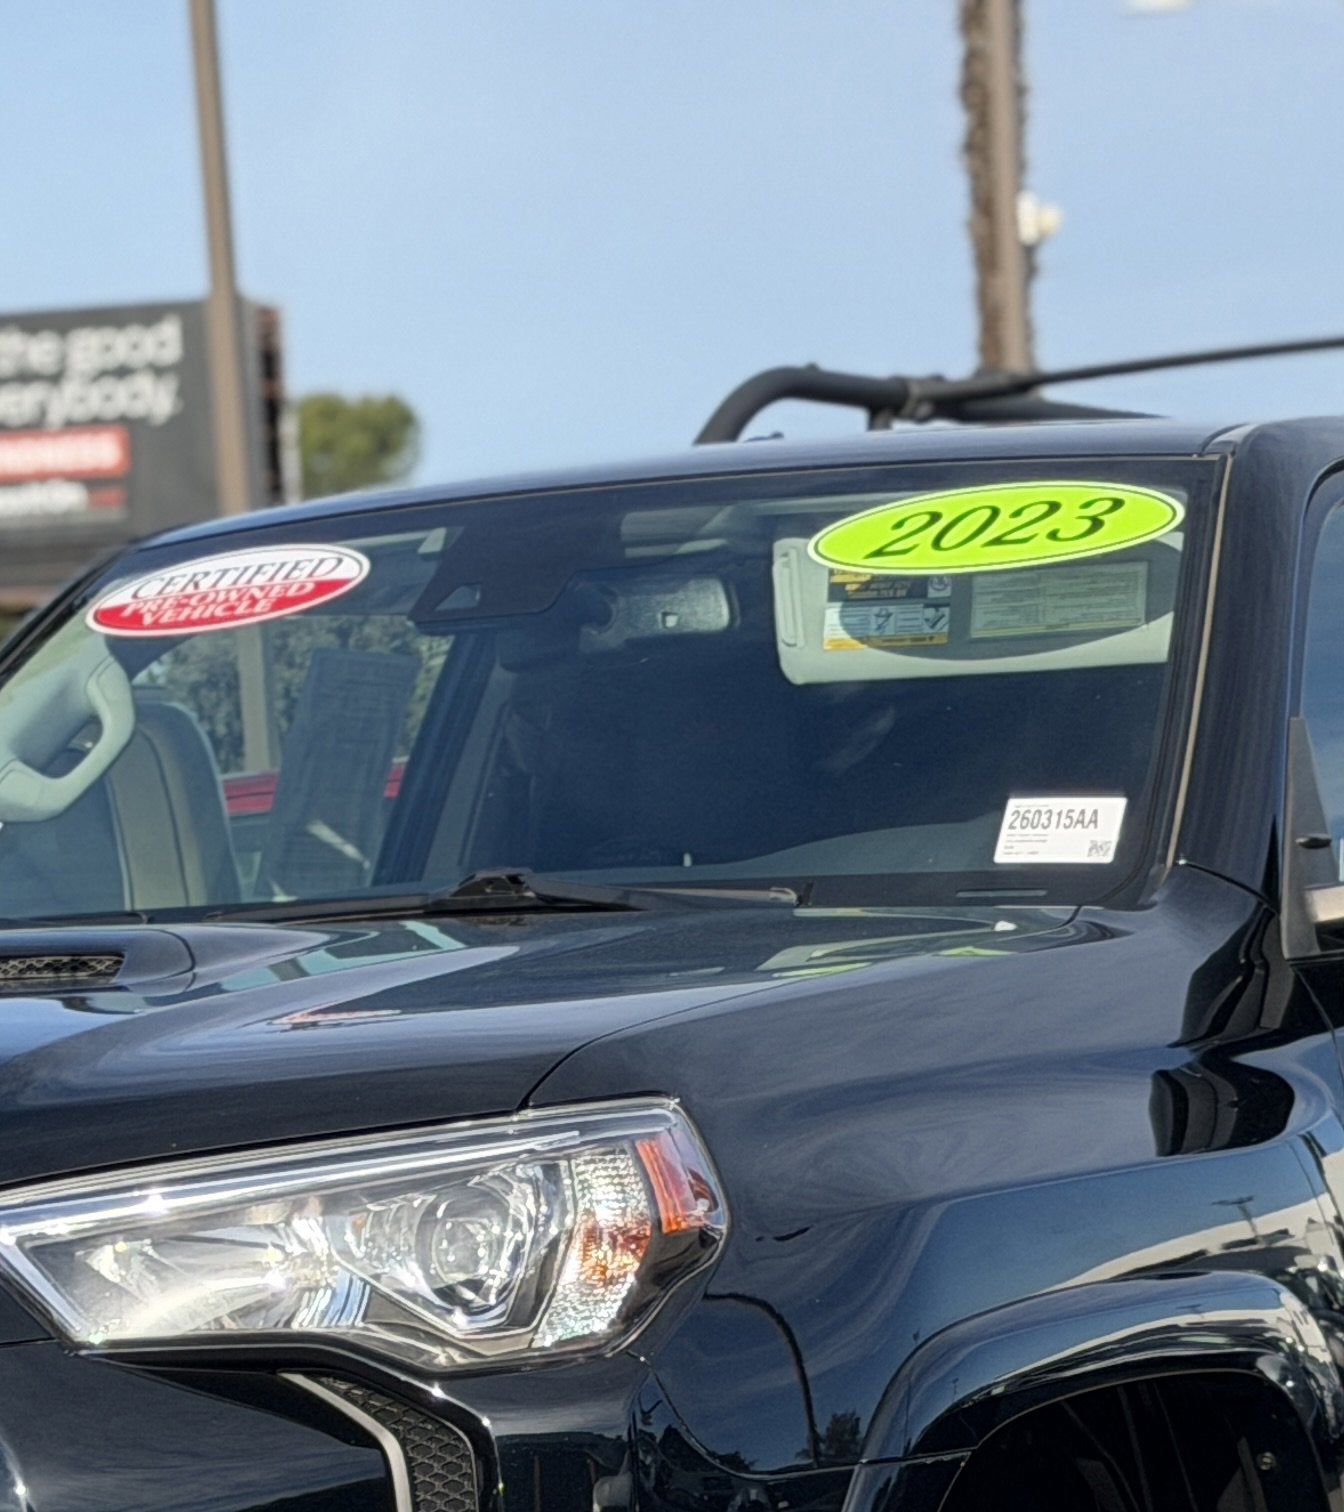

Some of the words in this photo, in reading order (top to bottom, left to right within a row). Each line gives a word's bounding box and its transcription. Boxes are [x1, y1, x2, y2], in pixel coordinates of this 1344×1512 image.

[863, 497, 1125, 560] 2023
[131, 557, 344, 599] CERTIFIED
[120, 581, 315, 618] PRE-OWNED
[141, 597, 276, 627] VEHICLE
[1008, 808, 1099, 830] 260315AA
